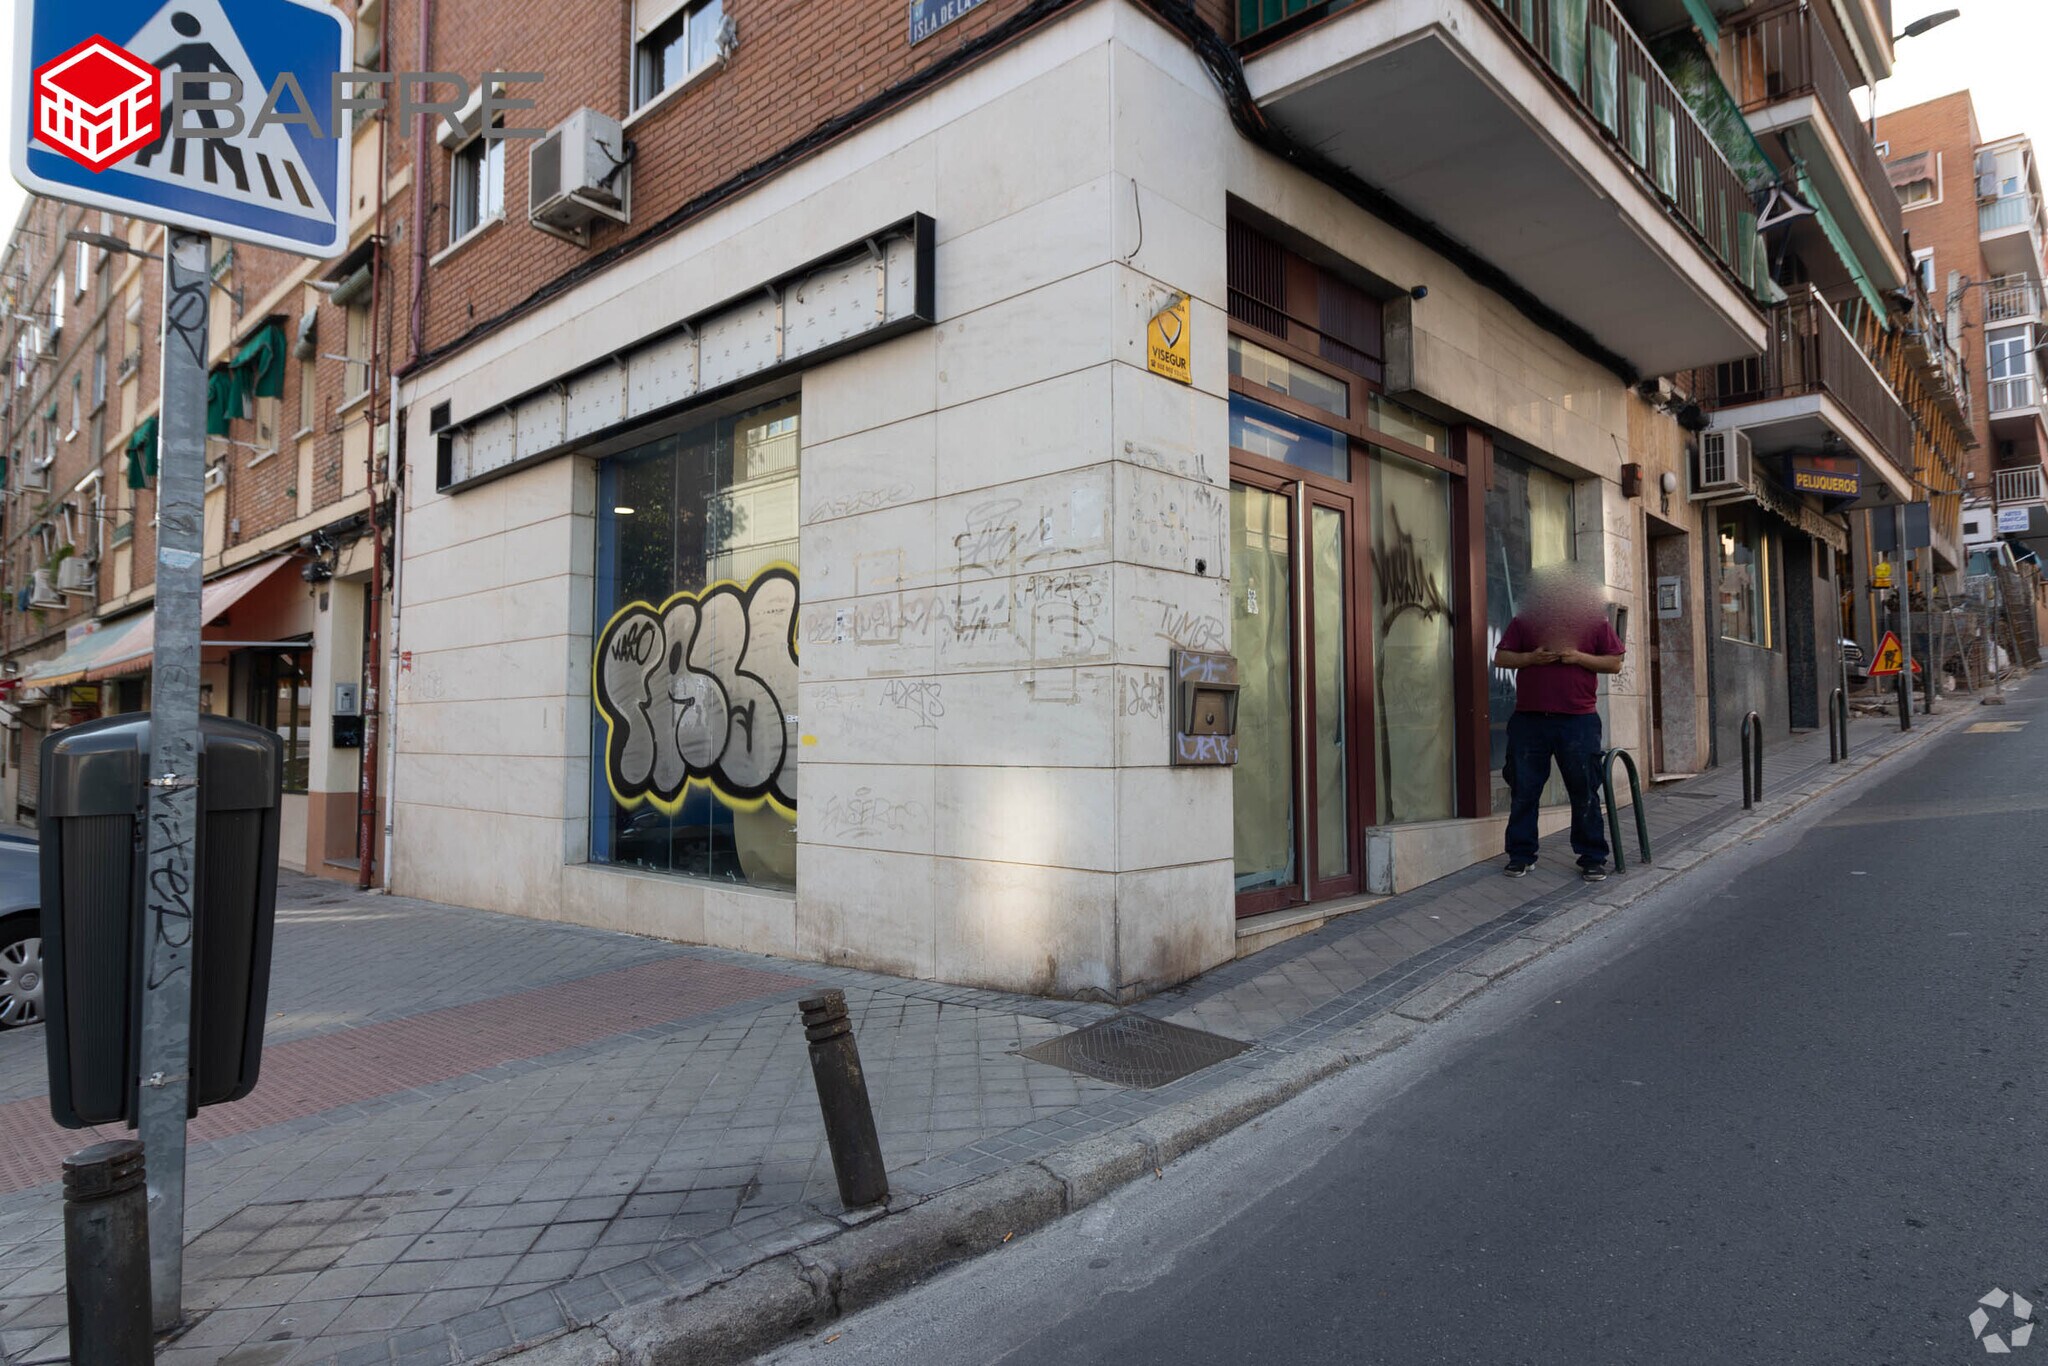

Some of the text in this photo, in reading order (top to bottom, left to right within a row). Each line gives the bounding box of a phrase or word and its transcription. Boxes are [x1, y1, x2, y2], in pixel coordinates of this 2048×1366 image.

[913, 12, 937, 41] ISLA
[940, 2, 955, 24] DE
[1152, 346, 1187, 370] VISEGUR
[1796, 473, 1858, 494] PELUQUEROS
